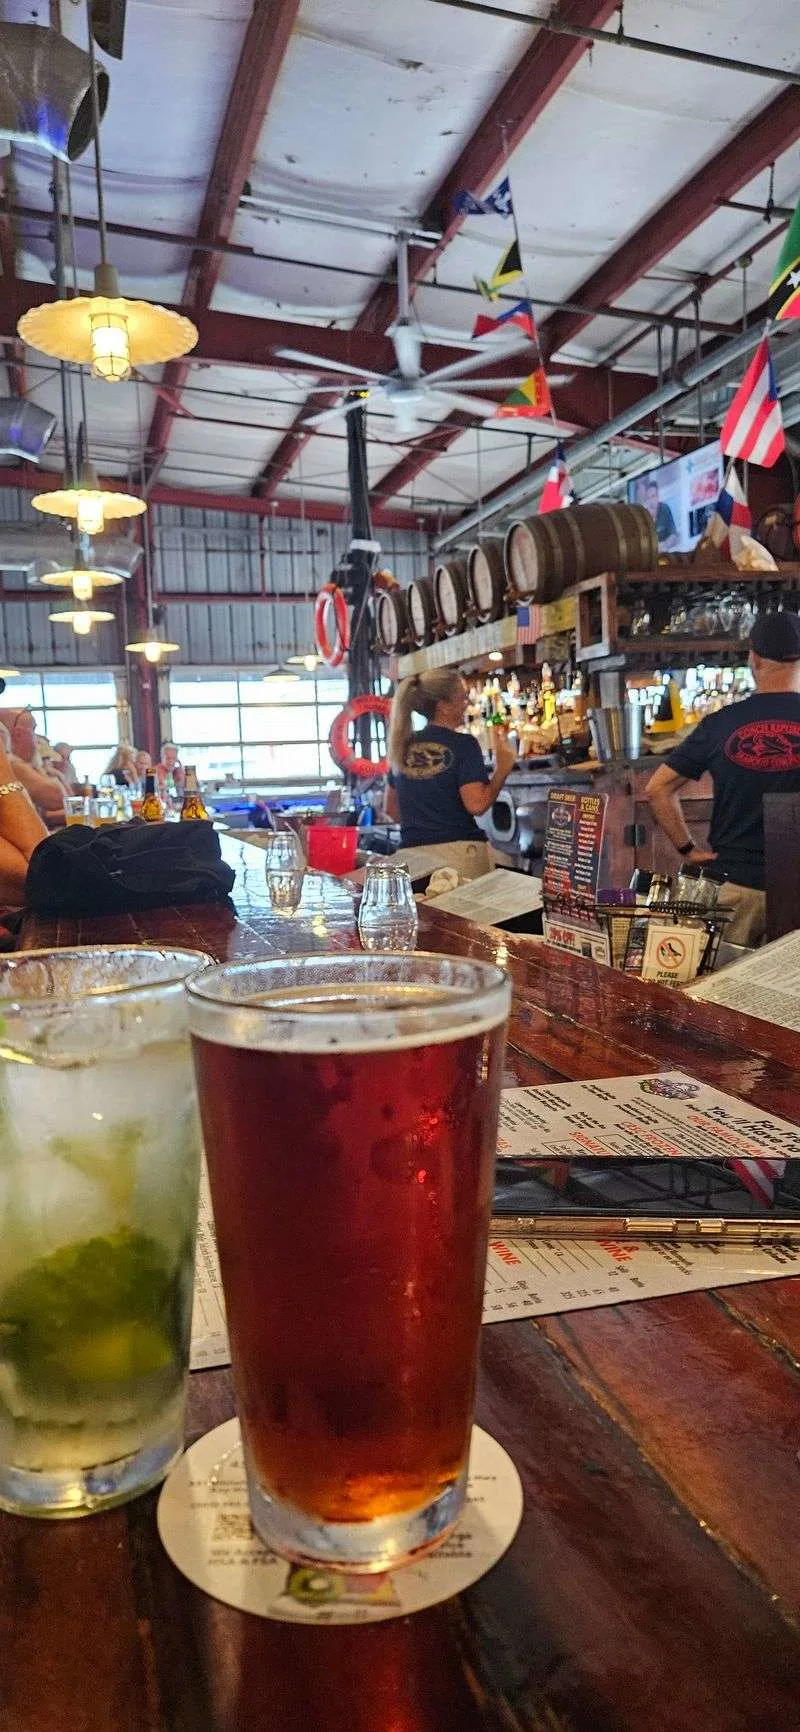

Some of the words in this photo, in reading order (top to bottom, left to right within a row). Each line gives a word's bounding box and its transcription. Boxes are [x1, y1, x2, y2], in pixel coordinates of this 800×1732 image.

[656, 970, 678, 979] PLEASE
[708, 1106, 752, 1124] You'll
[742, 1125, 784, 1143] Have
[755, 1120, 782, 1131] For
[641, 1134, 684, 1156] FROZEN
[489, 1240, 522, 1265] WINE
[598, 1239, 632, 1262] WINE
